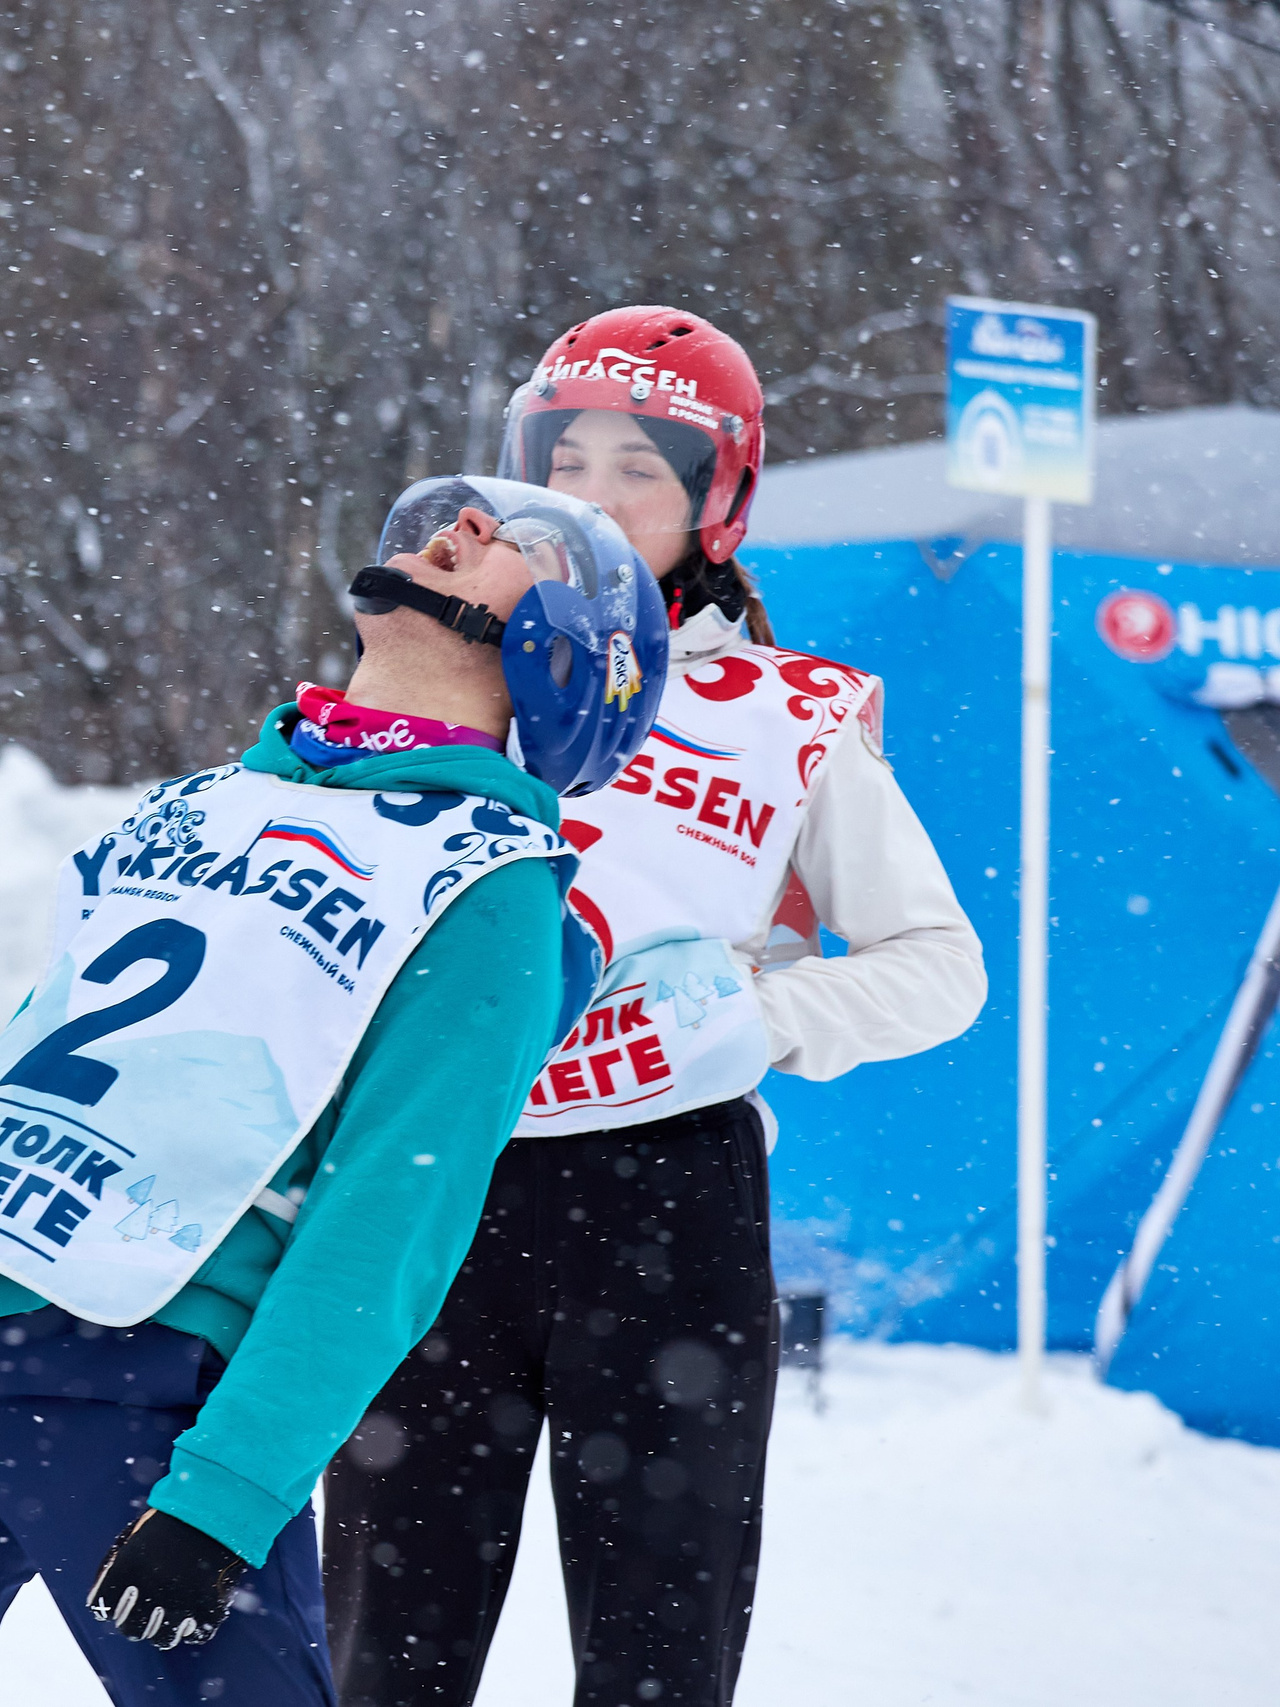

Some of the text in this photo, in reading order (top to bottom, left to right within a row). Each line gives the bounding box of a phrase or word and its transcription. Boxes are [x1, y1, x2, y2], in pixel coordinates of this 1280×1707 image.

[610, 754, 776, 848] SSEN
[676, 824, 740, 857] СНЕЖНЫЙ
[280, 925, 338, 978] СНЕЖНЫЙ
